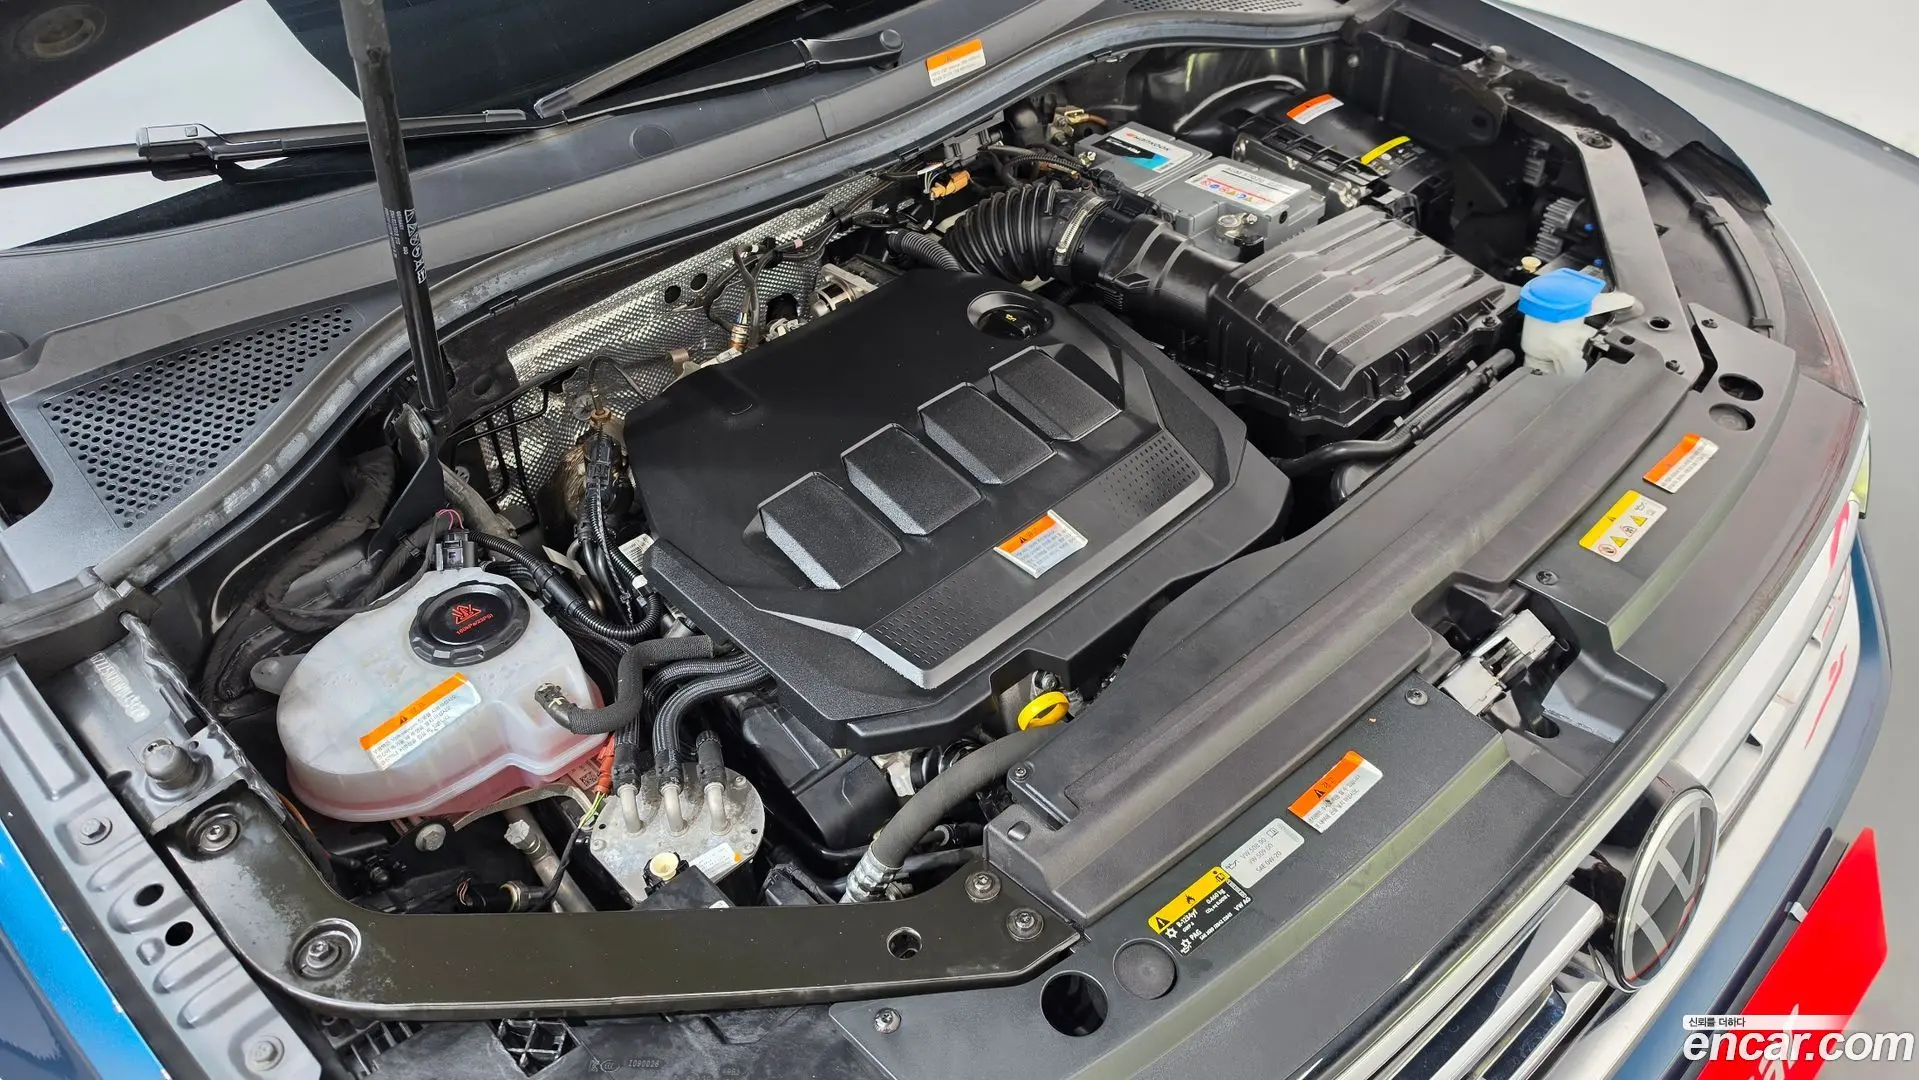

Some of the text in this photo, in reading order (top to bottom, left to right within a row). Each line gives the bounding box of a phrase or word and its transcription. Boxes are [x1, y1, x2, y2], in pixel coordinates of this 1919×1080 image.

[1233, 896, 1252, 912] VW AG
[1189, 928, 1203, 942] PAG
